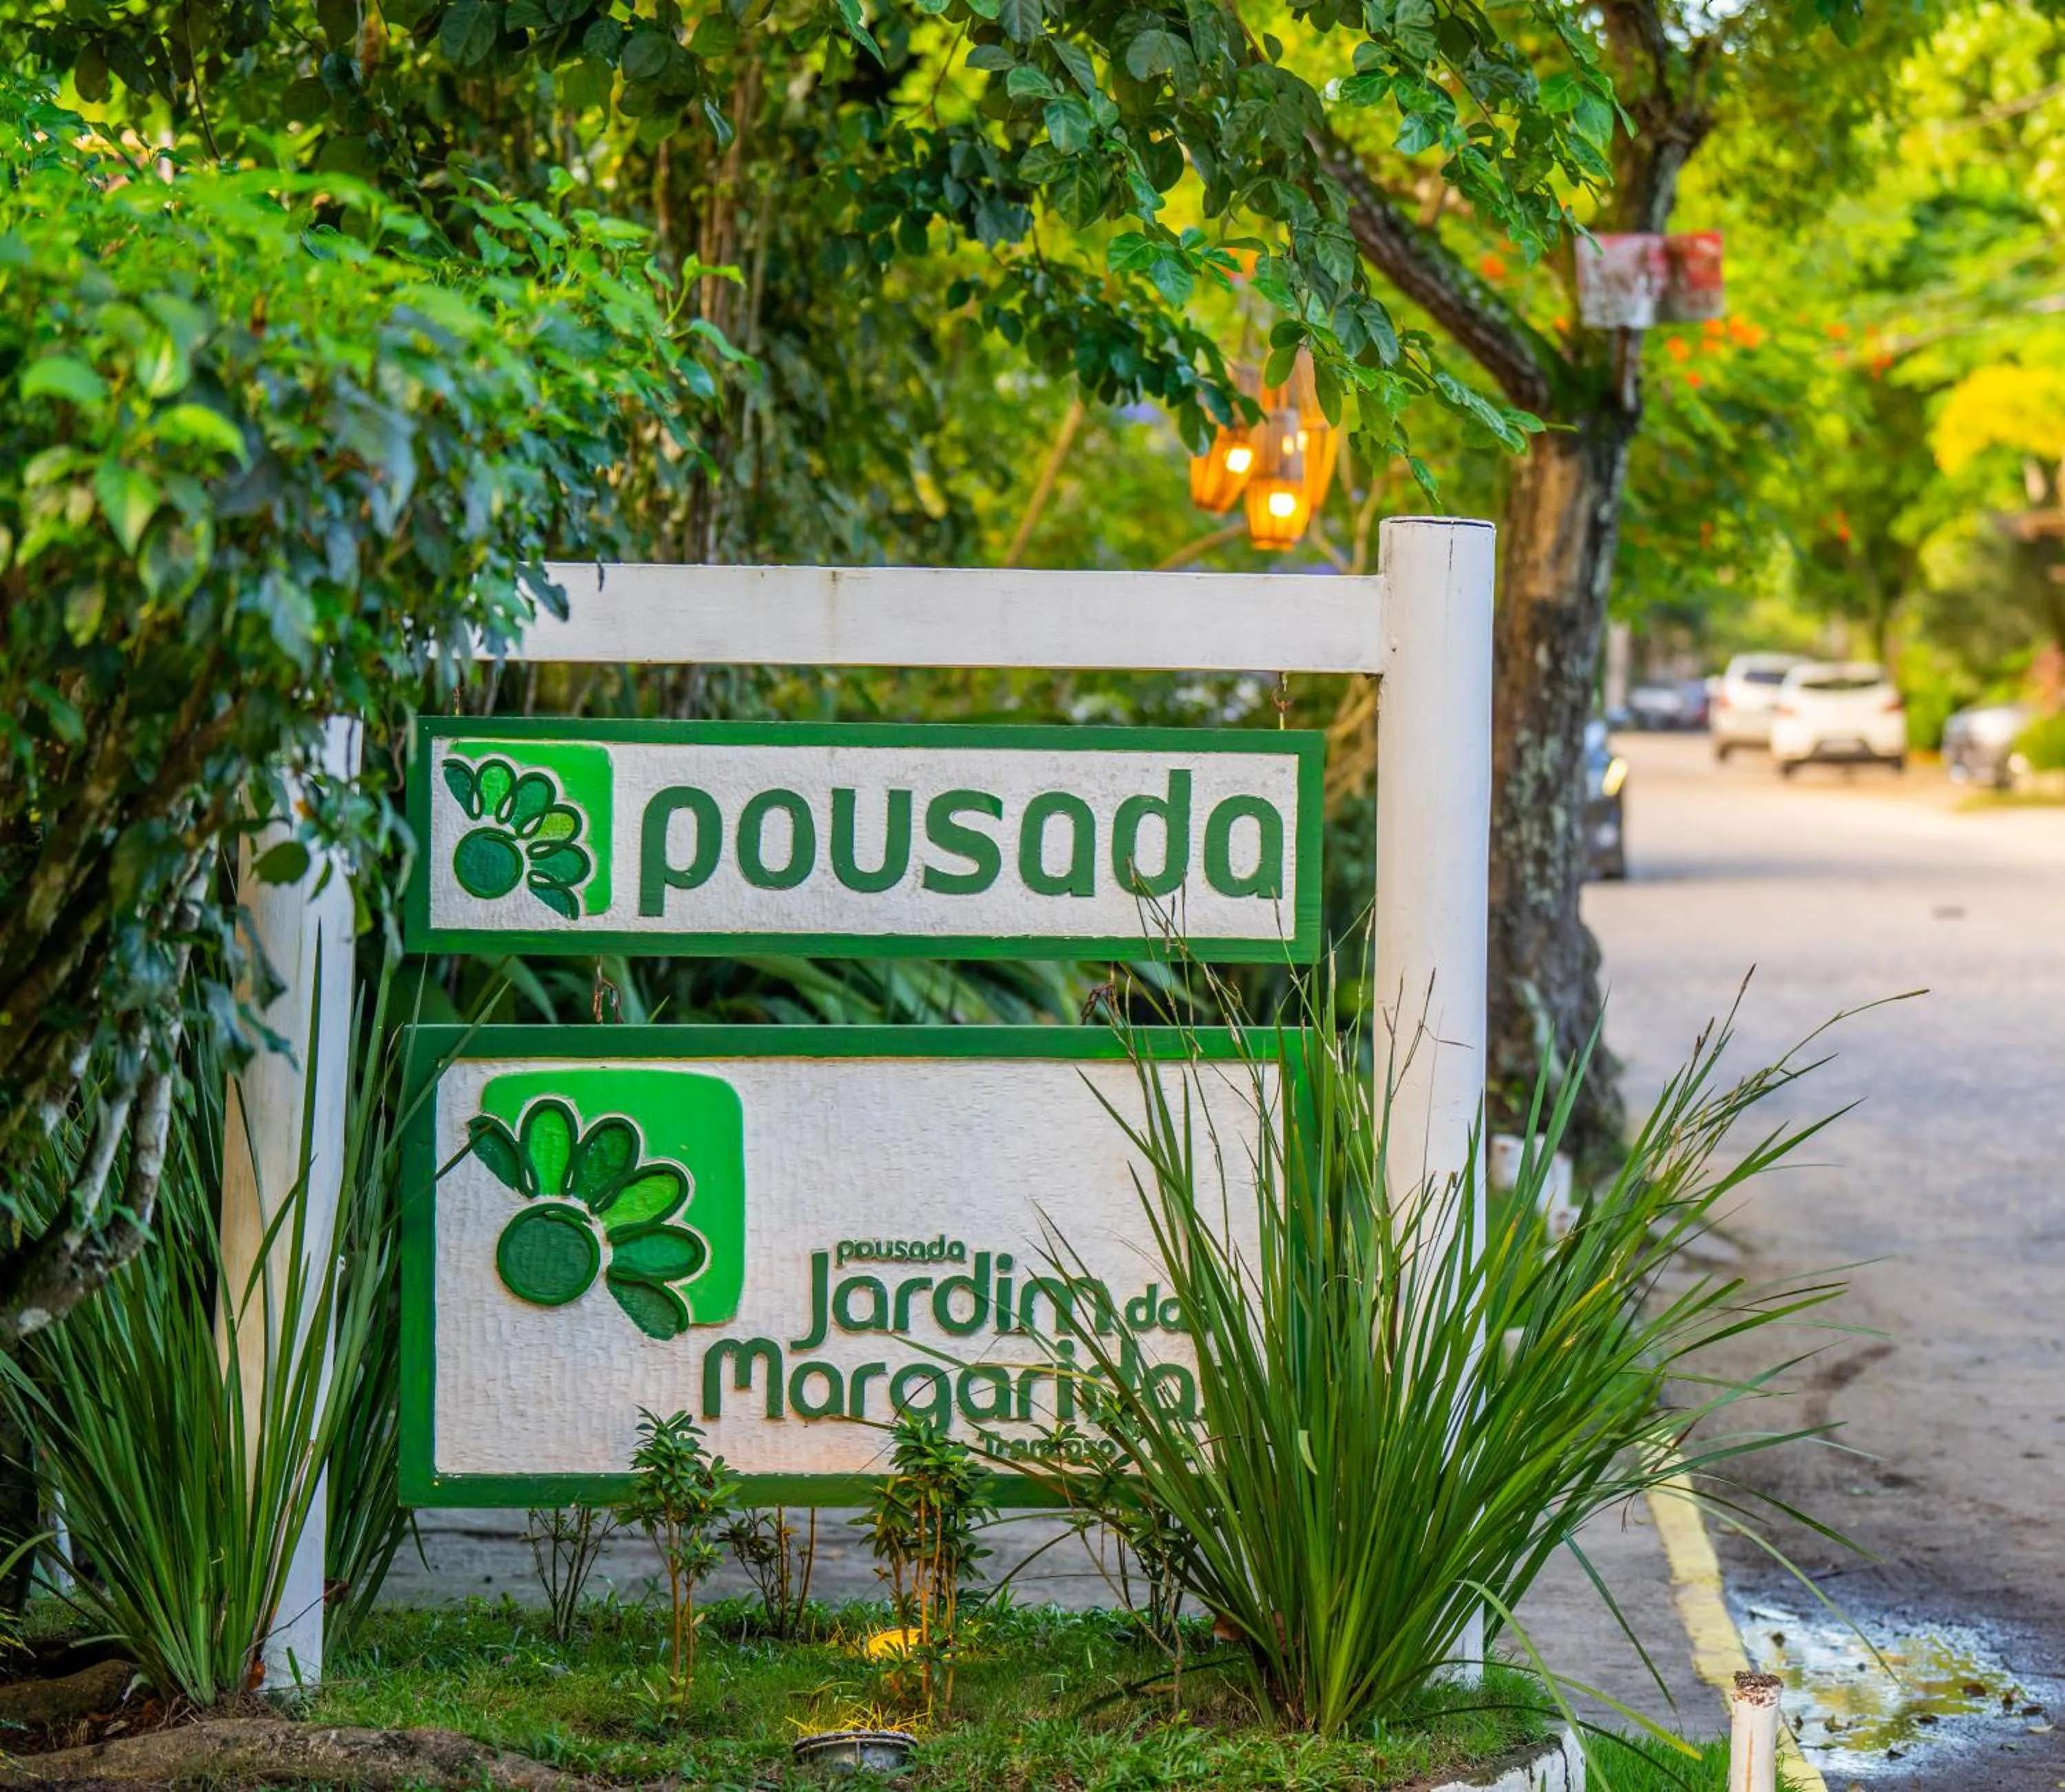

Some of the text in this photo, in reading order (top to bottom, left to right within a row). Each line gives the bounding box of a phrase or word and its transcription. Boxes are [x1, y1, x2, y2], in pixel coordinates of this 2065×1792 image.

[639, 769, 1284, 917] pousada
[790, 1251, 1216, 1350] Jardim da
[836, 1234, 966, 1267] pousada
[702, 1336, 1225, 1438] Margarida
